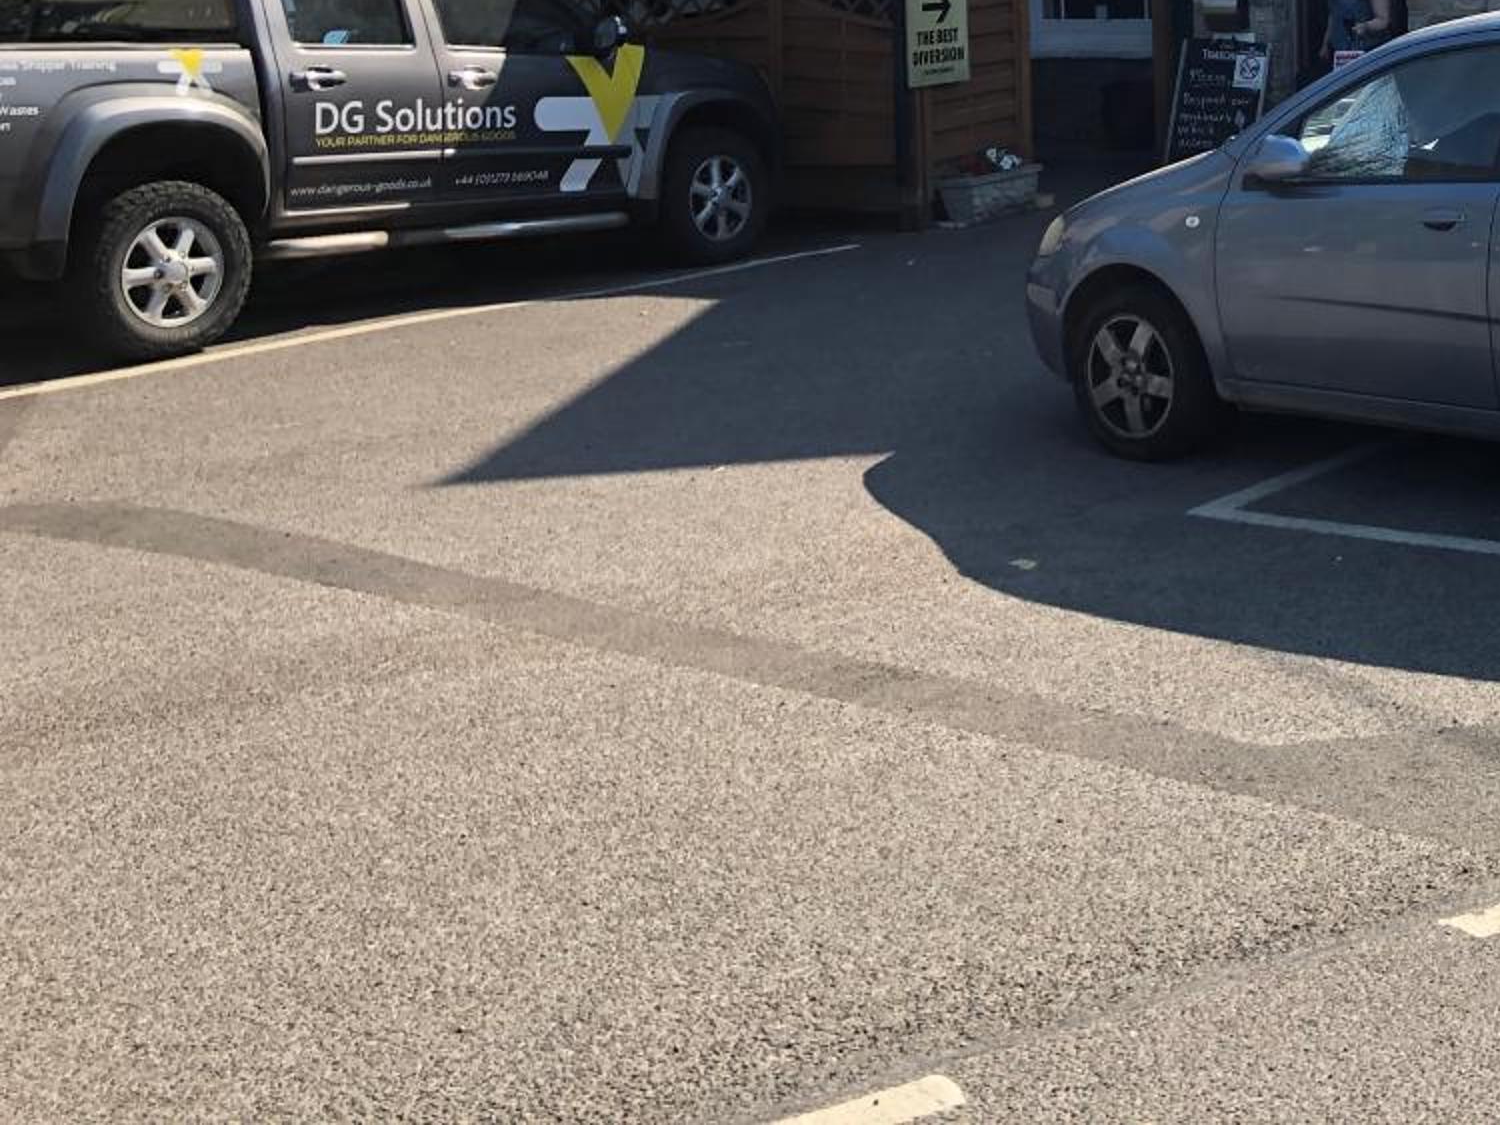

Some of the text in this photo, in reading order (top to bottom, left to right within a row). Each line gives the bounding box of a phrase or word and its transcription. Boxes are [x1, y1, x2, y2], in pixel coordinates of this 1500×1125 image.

[917, 27, 959, 46] THE BEST
[912, 47, 965, 66] DIVERSION
[315, 97, 518, 135] DG Solutions
[315, 129, 517, 148] YOUR PARTNER FOR DANGEROUS GOODS
